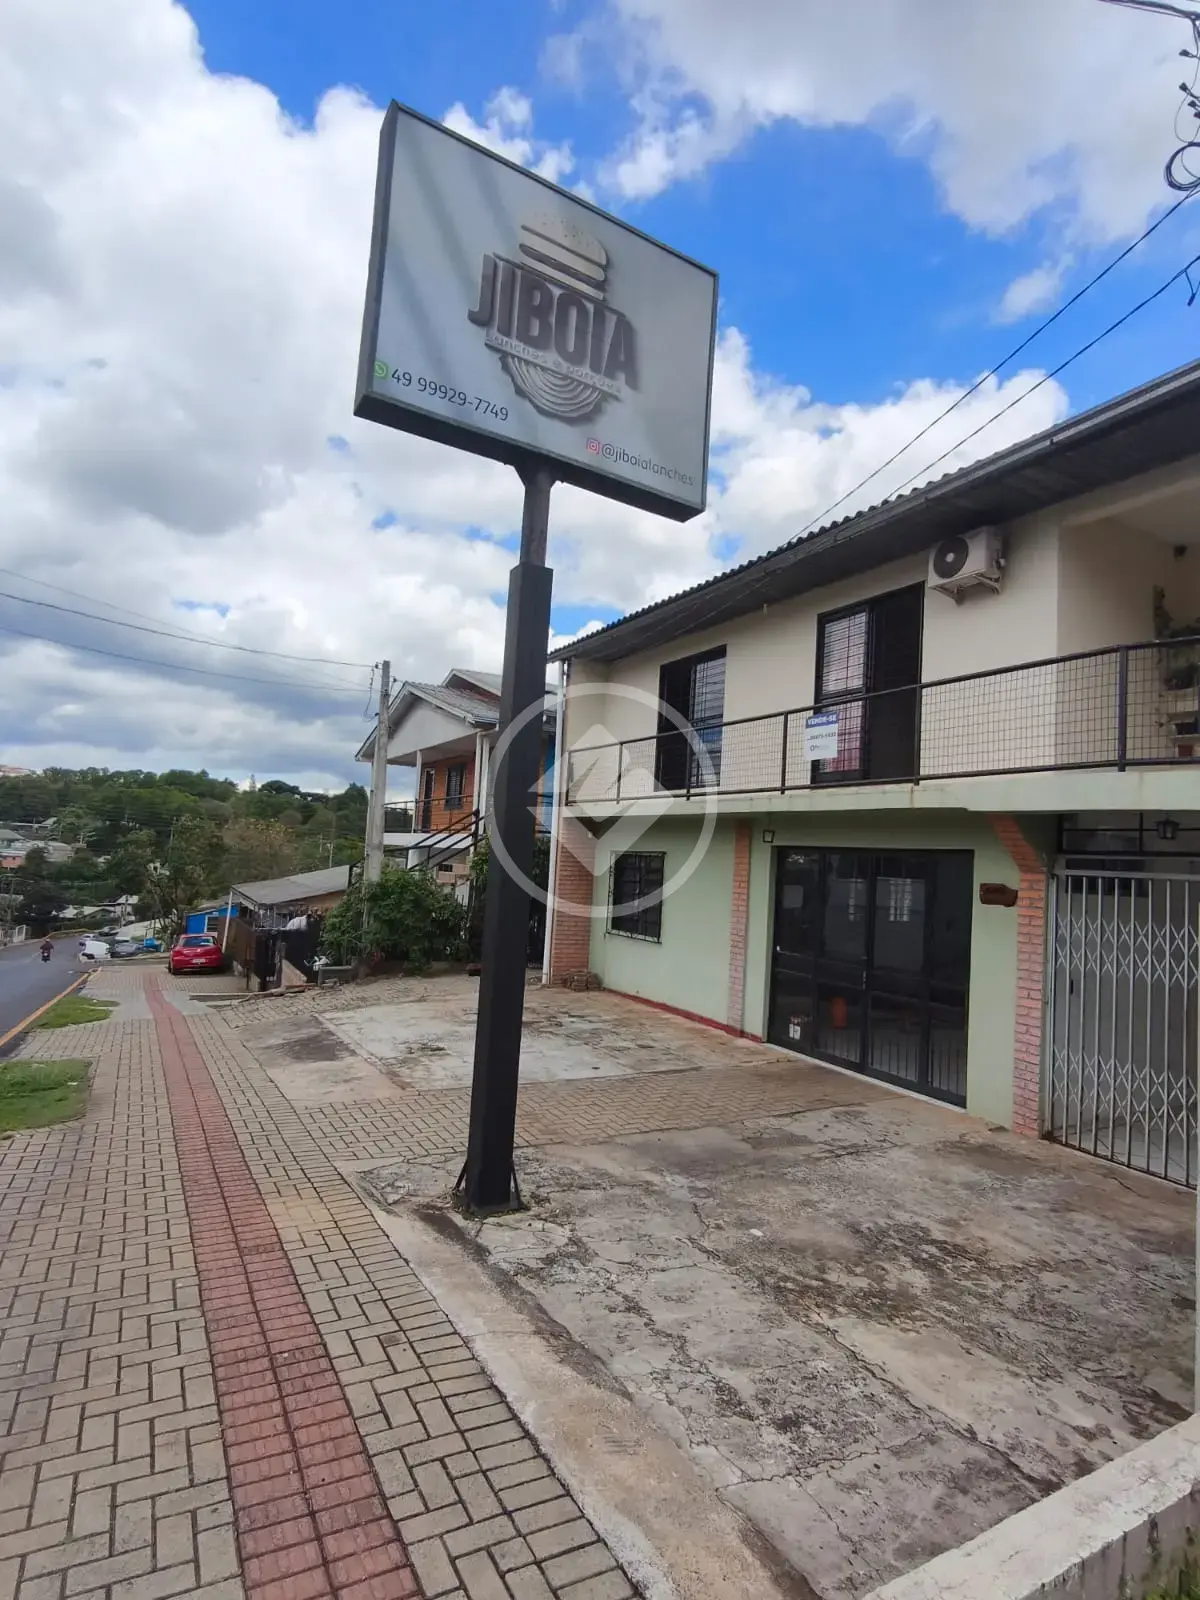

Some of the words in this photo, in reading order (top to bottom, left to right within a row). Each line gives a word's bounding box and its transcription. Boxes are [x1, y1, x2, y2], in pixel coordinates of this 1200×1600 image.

[467, 253, 638, 391] JIBOIA
[391, 368, 412, 387] 49
[417, 377, 509, 421] 99929-7749
[601, 443, 695, 486] @jiboialanches
